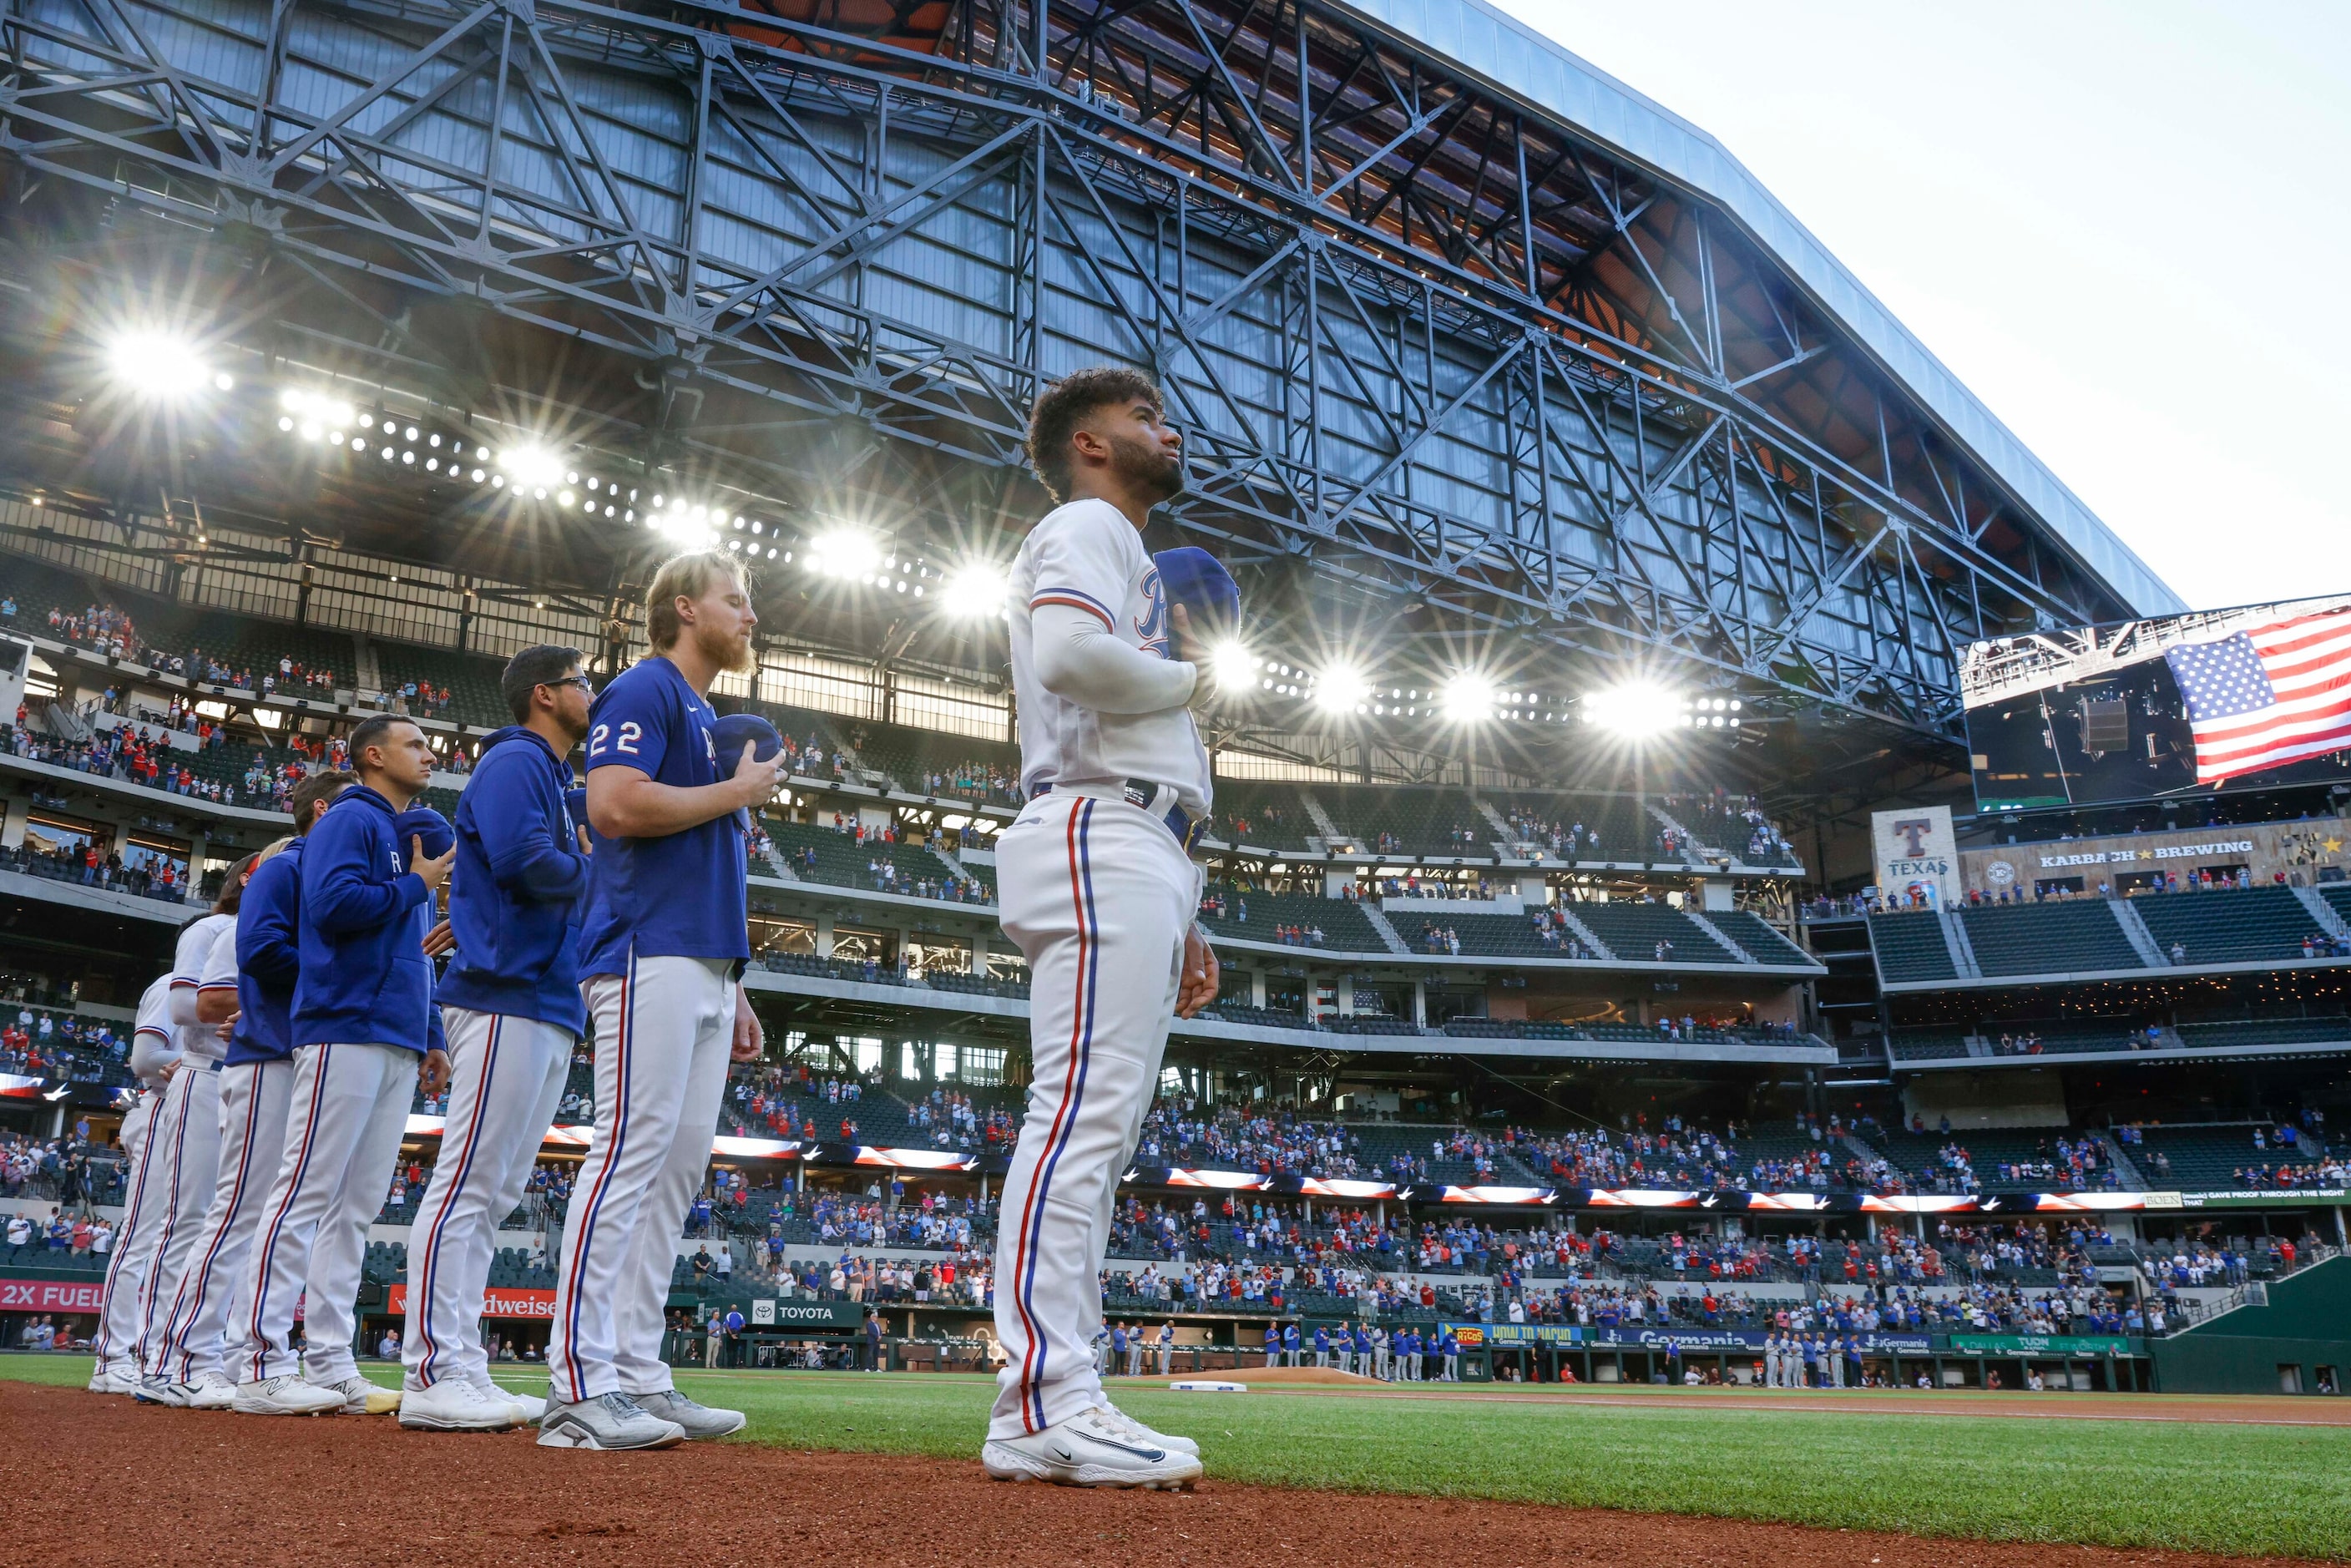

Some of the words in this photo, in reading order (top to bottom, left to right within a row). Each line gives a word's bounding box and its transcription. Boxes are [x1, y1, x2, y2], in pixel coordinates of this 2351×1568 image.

[589, 721, 643, 757] 22
[1894, 818, 1931, 857] T
[2040, 850, 2136, 867] KARBACH
[2154, 841, 2253, 859] BREWING
[1888, 860, 1949, 877] TEXAS
[2, 1285, 36, 1305] 2X
[43, 1287, 103, 1308] FUEL
[483, 1294, 557, 1316] dweise
[779, 1307, 833, 1320] TOYOTA
[1493, 1326, 1519, 1339] HOW
[1521, 1326, 1534, 1339] TO
[1537, 1326, 1571, 1340] NACHO
[1640, 1331, 1746, 1345] Germania
[1883, 1338, 1928, 1348] Germania
